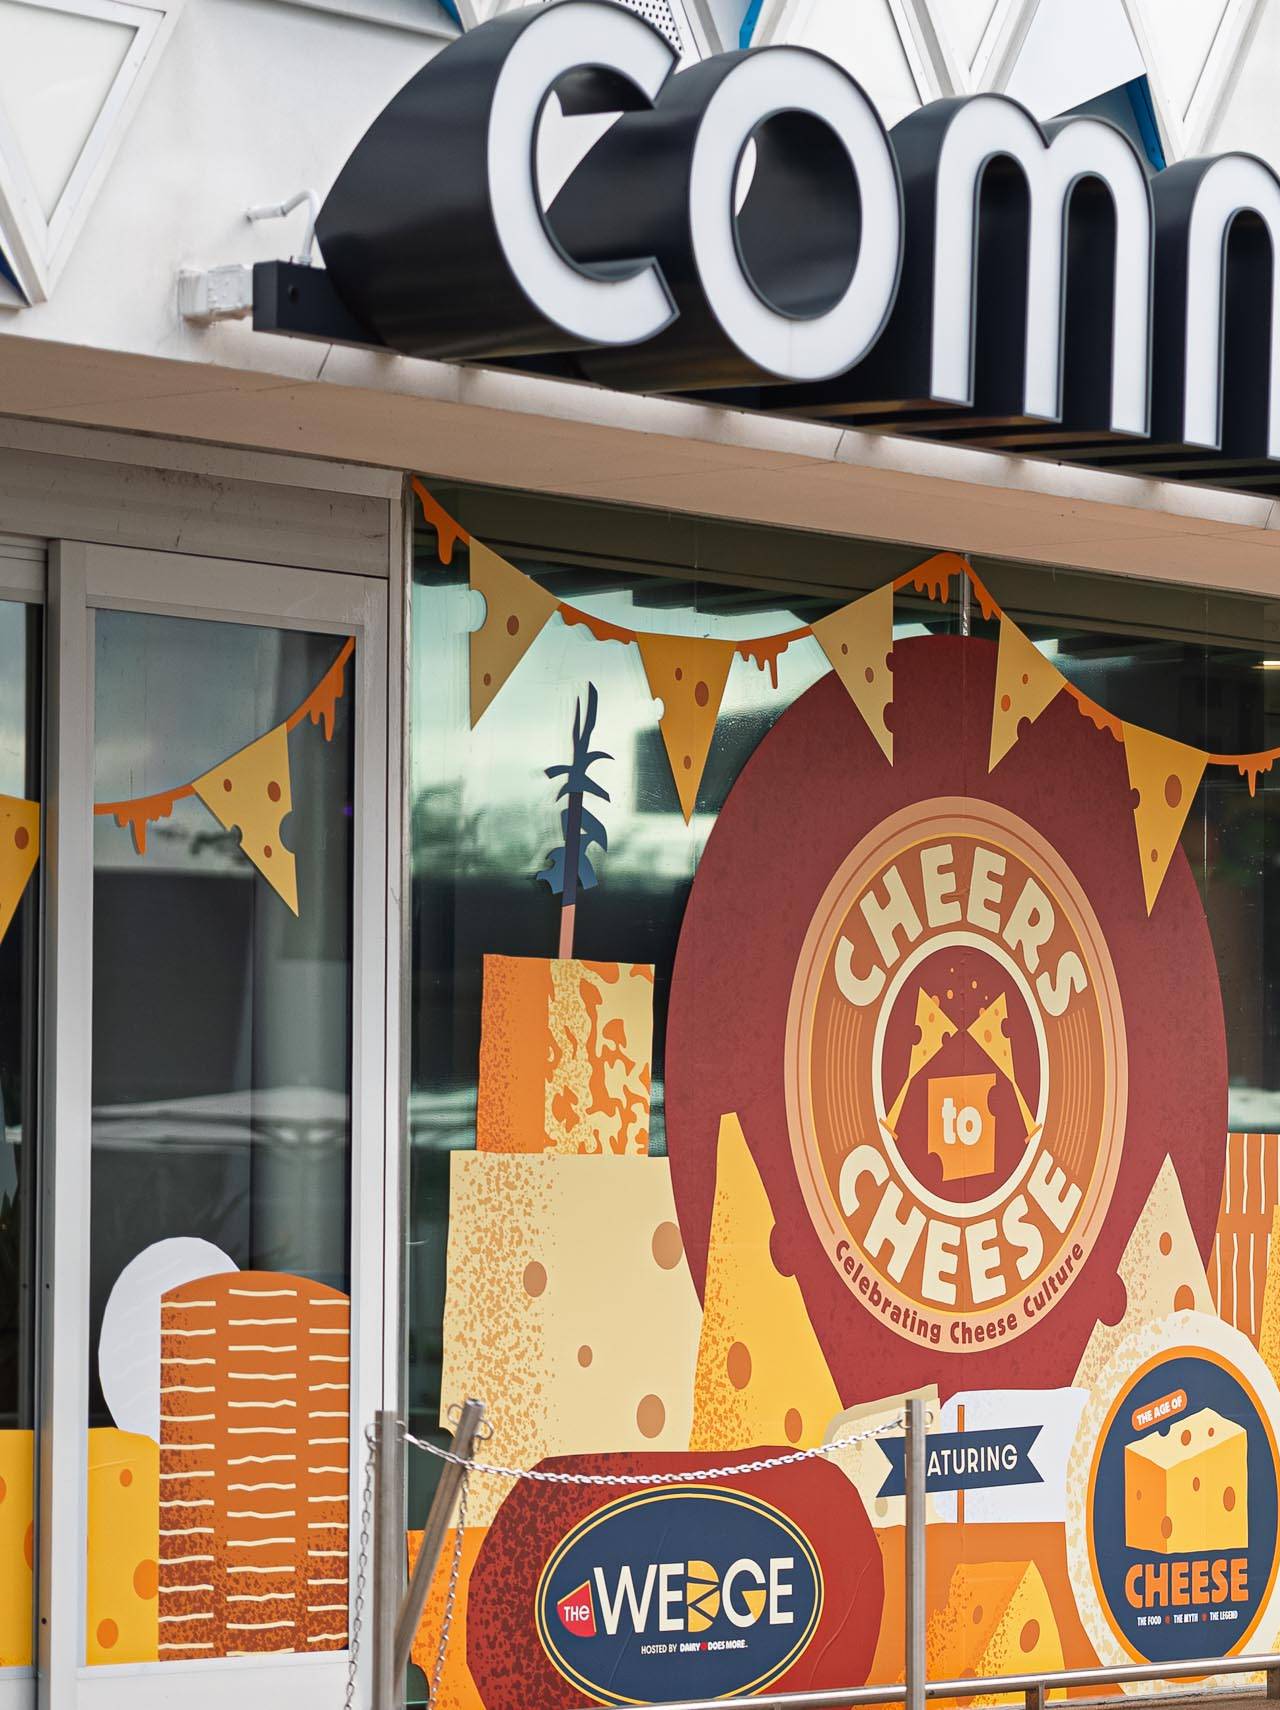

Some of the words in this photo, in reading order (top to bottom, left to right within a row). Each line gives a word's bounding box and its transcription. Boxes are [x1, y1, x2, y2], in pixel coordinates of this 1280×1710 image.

[834, 843, 1088, 1017] CHEERS
[941, 1098, 983, 1145] to
[838, 1144, 1083, 1305] CHEESE
[835, 1239, 941, 1344] Celebrating
[950, 1312, 1018, 1344] Cheese
[1023, 1242, 1083, 1318] Culture
[1136, 1409, 1154, 1426] THE
[1153, 1401, 1171, 1419] AGE
[1171, 1395, 1183, 1410] OF
[904, 1443, 1019, 1479] ATURING
[593, 1556, 794, 1636] WEDGE
[1125, 1557, 1249, 1609] CHEESE
[1137, 1616, 1147, 1627] THE
[1147, 1615, 1162, 1626] FOOD
[1173, 1613, 1183, 1624] THE
[1183, 1613, 1199, 1623] MYTH
[1209, 1611, 1219, 1621] THE
[1219, 1610, 1238, 1620] LEGEND
[640, 1644, 667, 1655] HOSTED
[668, 1643, 678, 1653] BY
[680, 1642, 701, 1653] DAIRY
[707, 1640, 725, 1651] DOES
